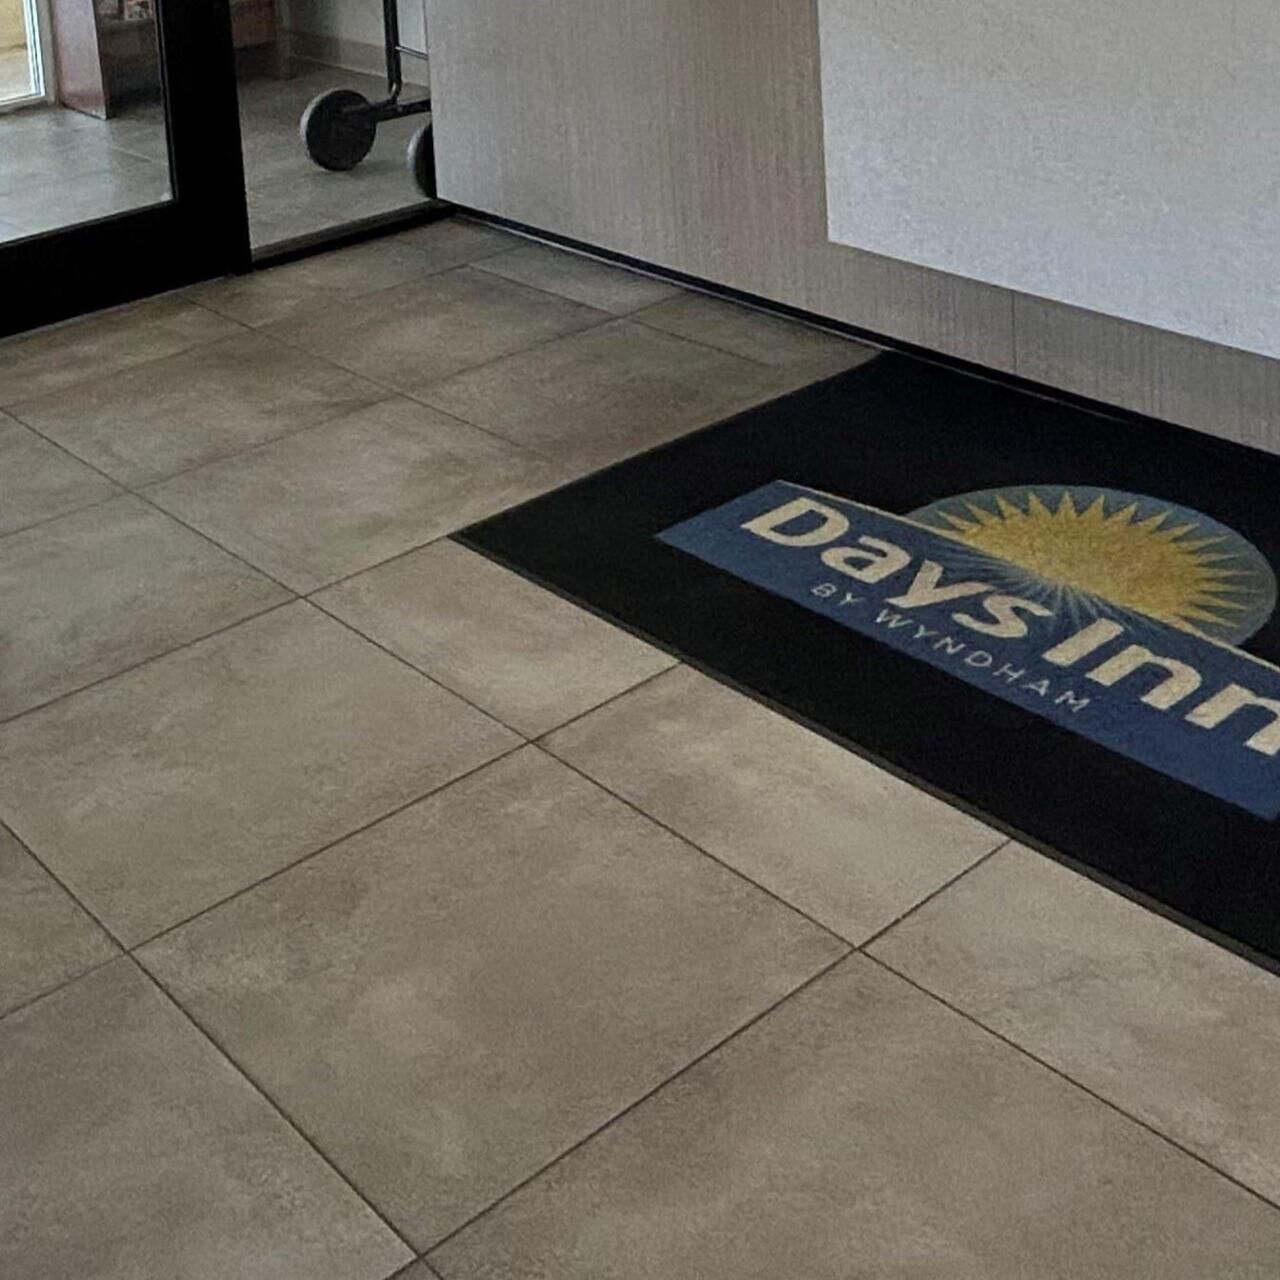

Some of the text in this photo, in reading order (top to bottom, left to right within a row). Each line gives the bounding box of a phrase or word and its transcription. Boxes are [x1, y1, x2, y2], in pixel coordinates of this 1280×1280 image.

[741, 497, 1053, 638] Days
[811, 583, 1091, 713] BY WYNDHAM
